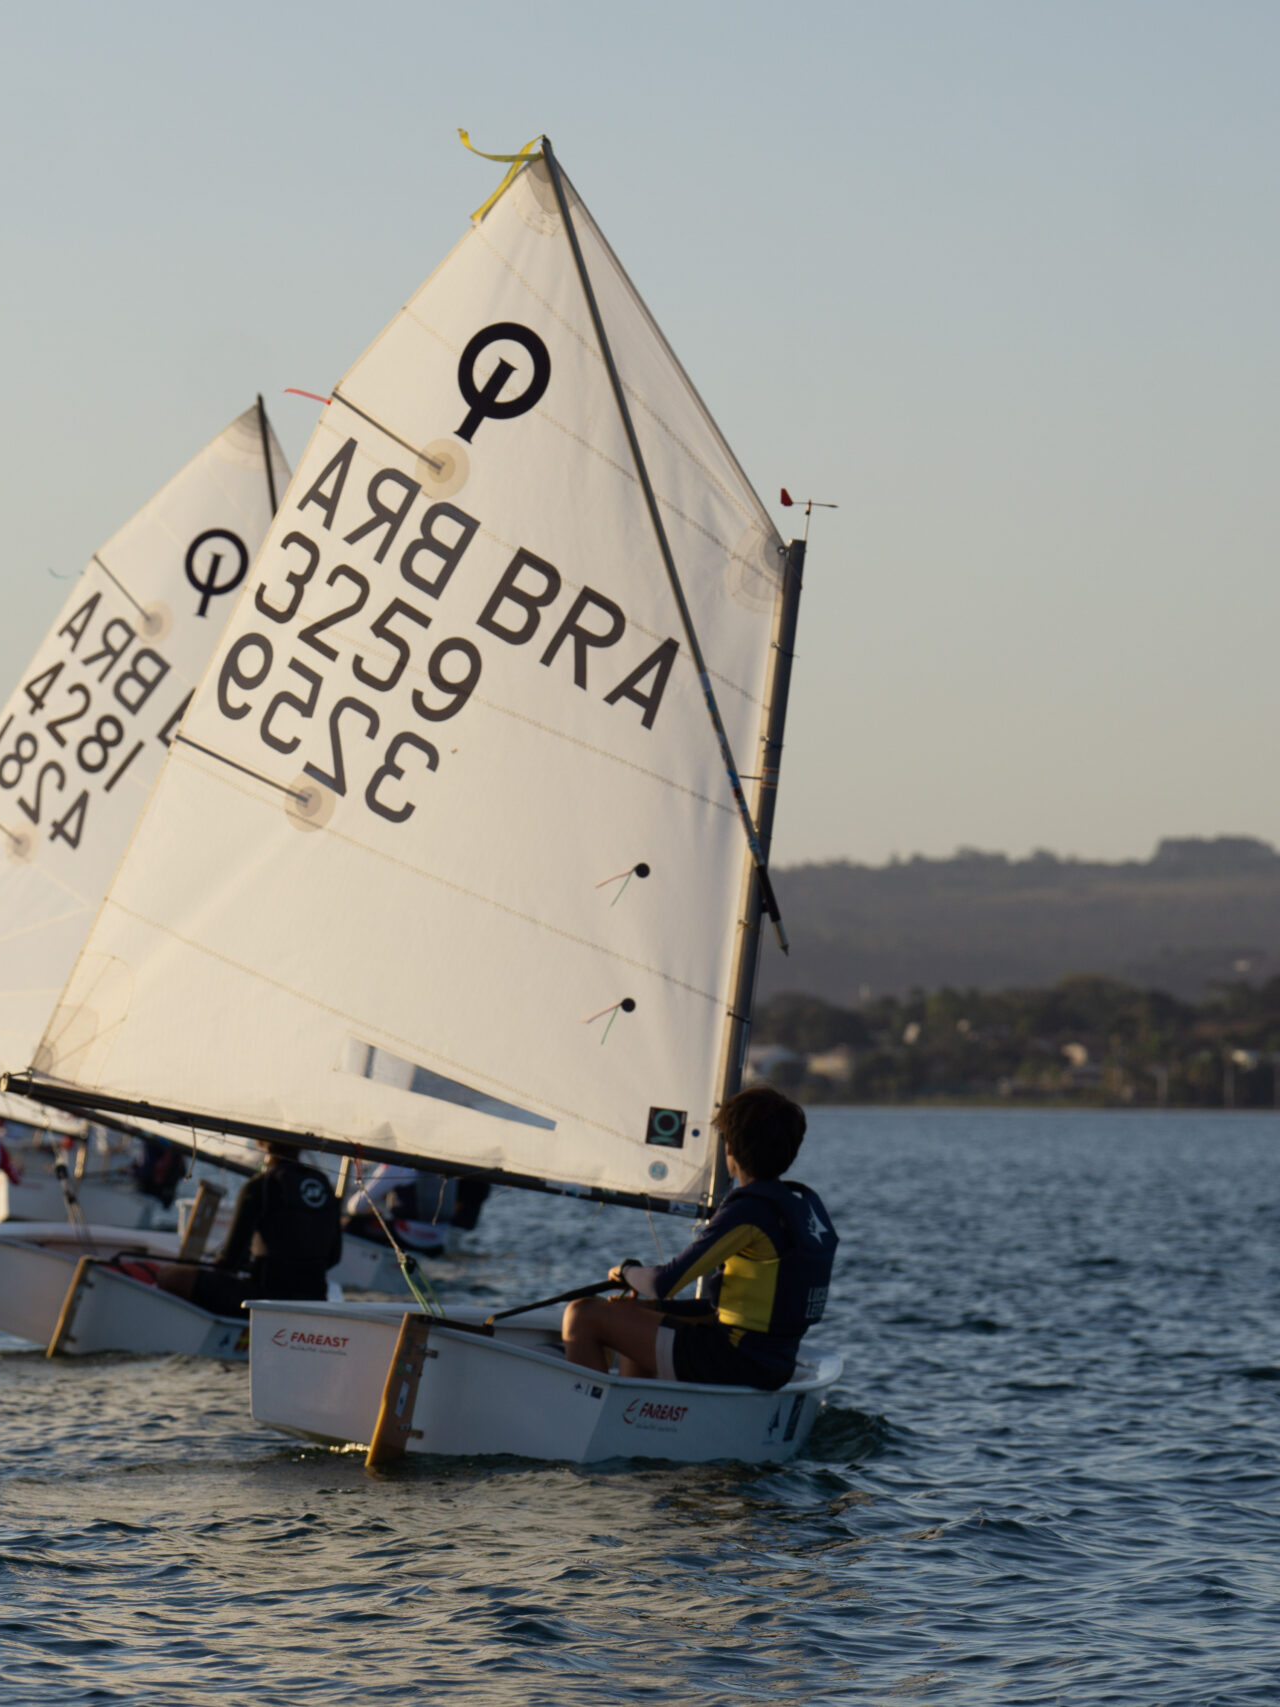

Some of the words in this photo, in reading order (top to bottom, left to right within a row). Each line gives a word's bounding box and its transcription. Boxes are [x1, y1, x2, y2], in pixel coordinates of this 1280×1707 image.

[254, 530, 482, 722] 3259
[475, 546, 680, 730] BRA
[23, 661, 145, 793] 4281
[290, 1331, 351, 1348] FAREAST
[639, 1402, 689, 1422] FAREAST
